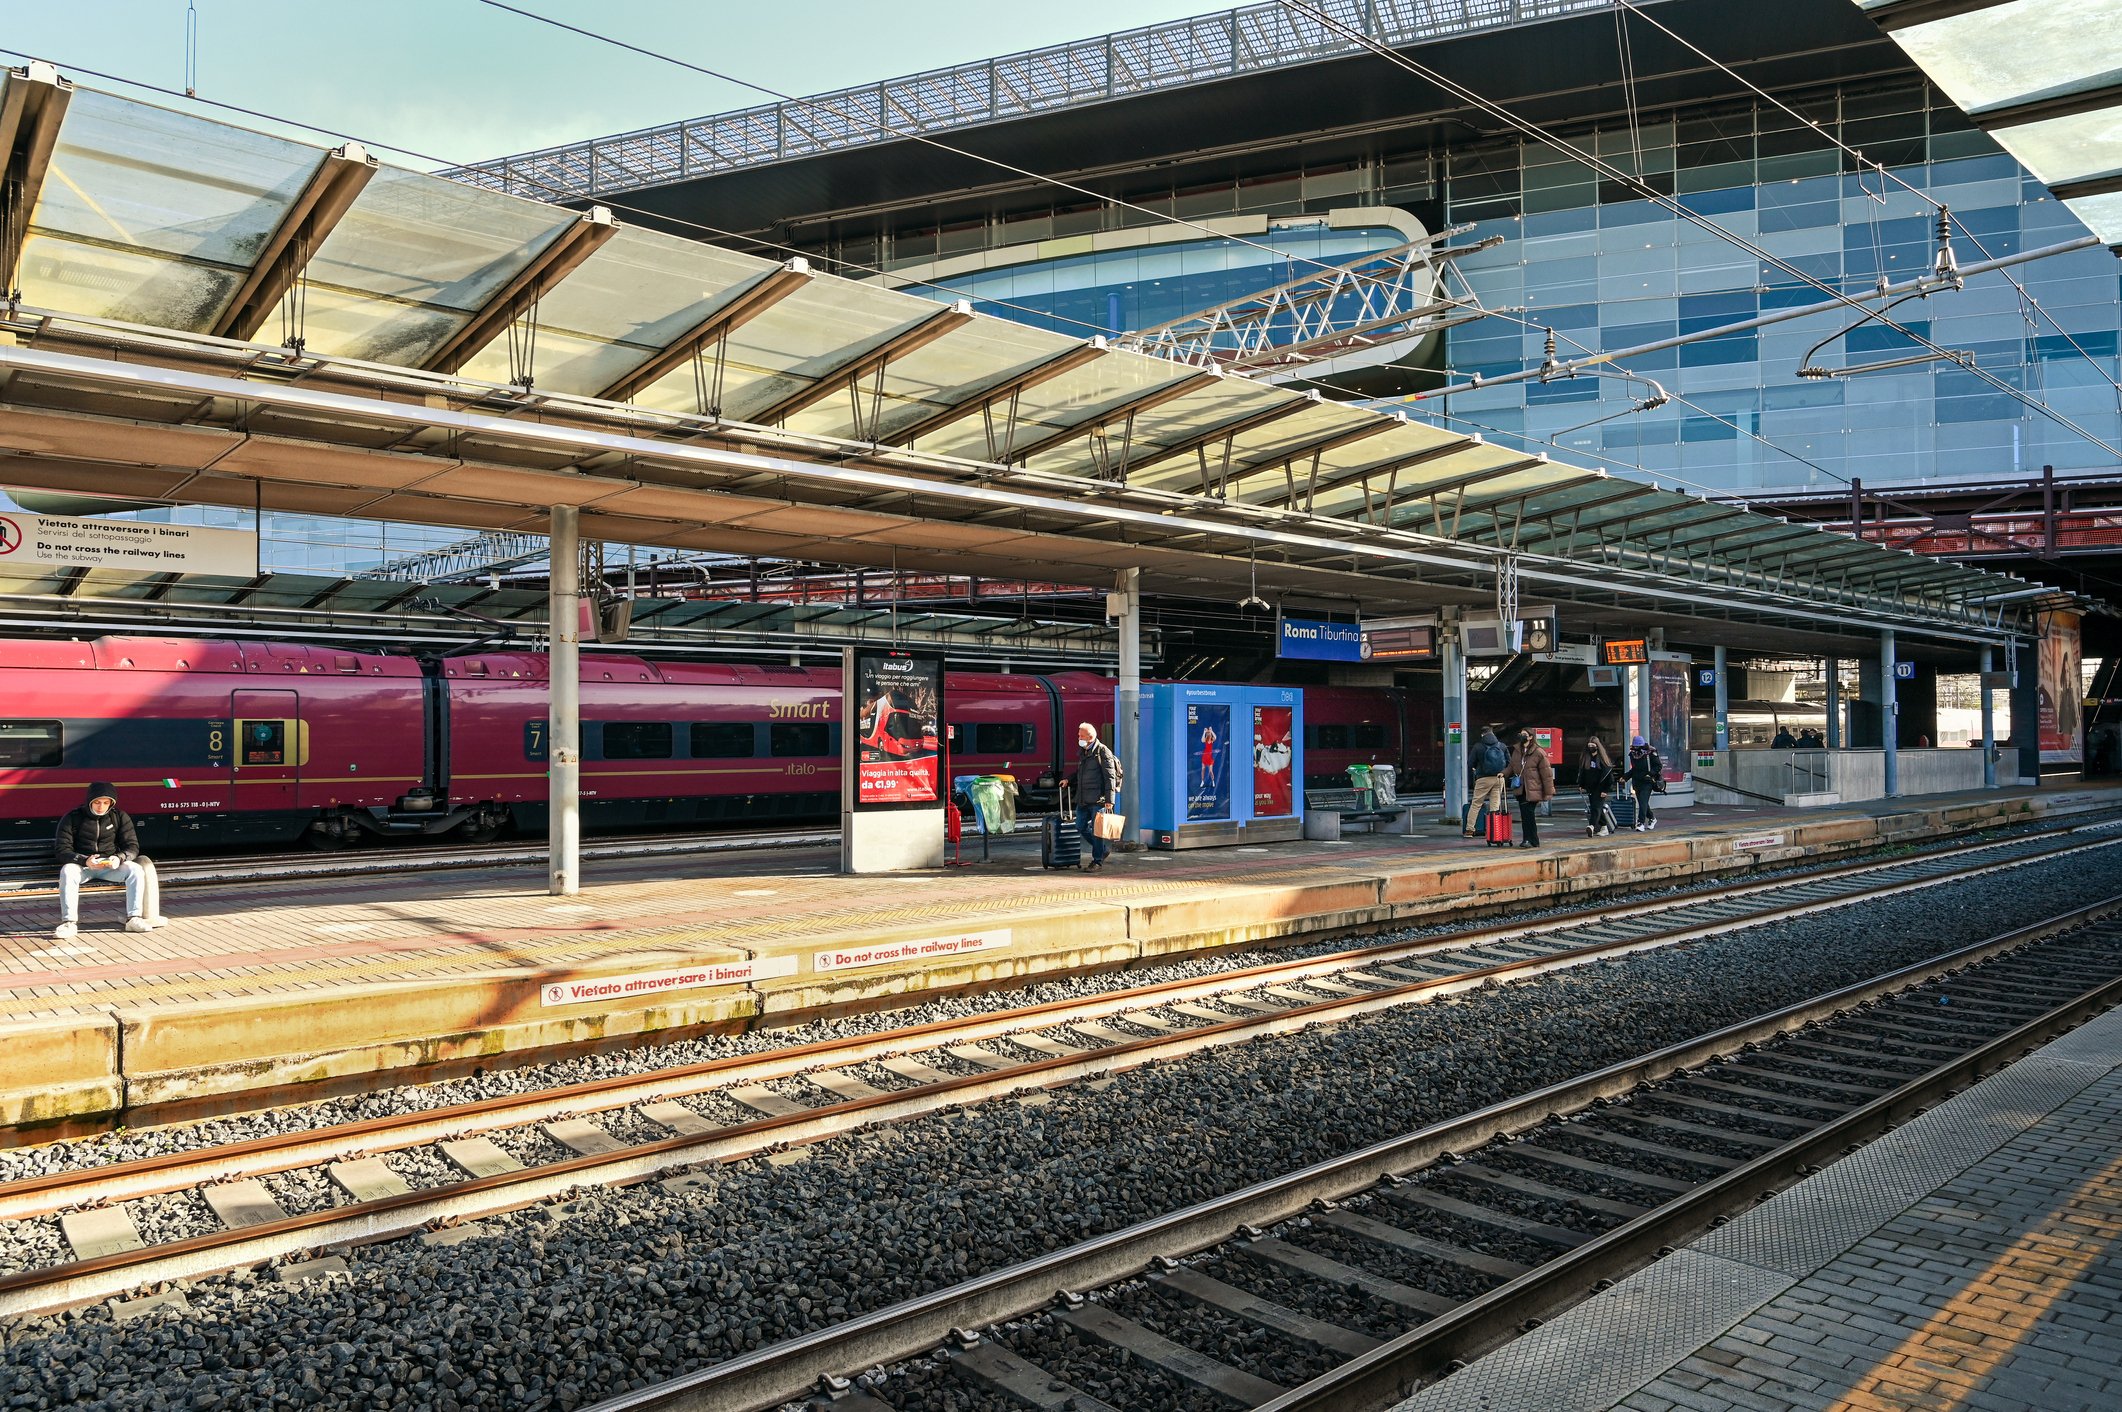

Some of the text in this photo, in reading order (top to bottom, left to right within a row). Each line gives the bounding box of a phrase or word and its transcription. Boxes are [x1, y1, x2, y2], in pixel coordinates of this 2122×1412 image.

[37, 528, 69, 536] Servirsi
[89, 532, 152, 545] sottopassaggio
[38, 518, 190, 538] Vietato attraversare i binari
[37, 541, 52, 550] Do
[75, 546, 101, 554] cross
[103, 546, 120, 555] the
[123, 548, 161, 559] railway
[163, 550, 186, 559] lines
[37, 551, 103, 563] Use the subway
[1284, 623, 1359, 642] Roma Tiburtina
[1533, 620, 1545, 630] 11
[1702, 674, 1712, 682] 12
[1899, 666, 1909, 675] 11
[769, 699, 830, 718] Smart
[209, 730, 223, 752] 8
[530, 730, 541, 749] 7
[1026, 730, 1033, 744] 7
[861, 769, 887, 779] Viaggia
[861, 780, 874, 789] da
[835, 937, 983, 965] Do not cross the railway lines
[570, 965, 752, 998] Vietato attraversare i binari
